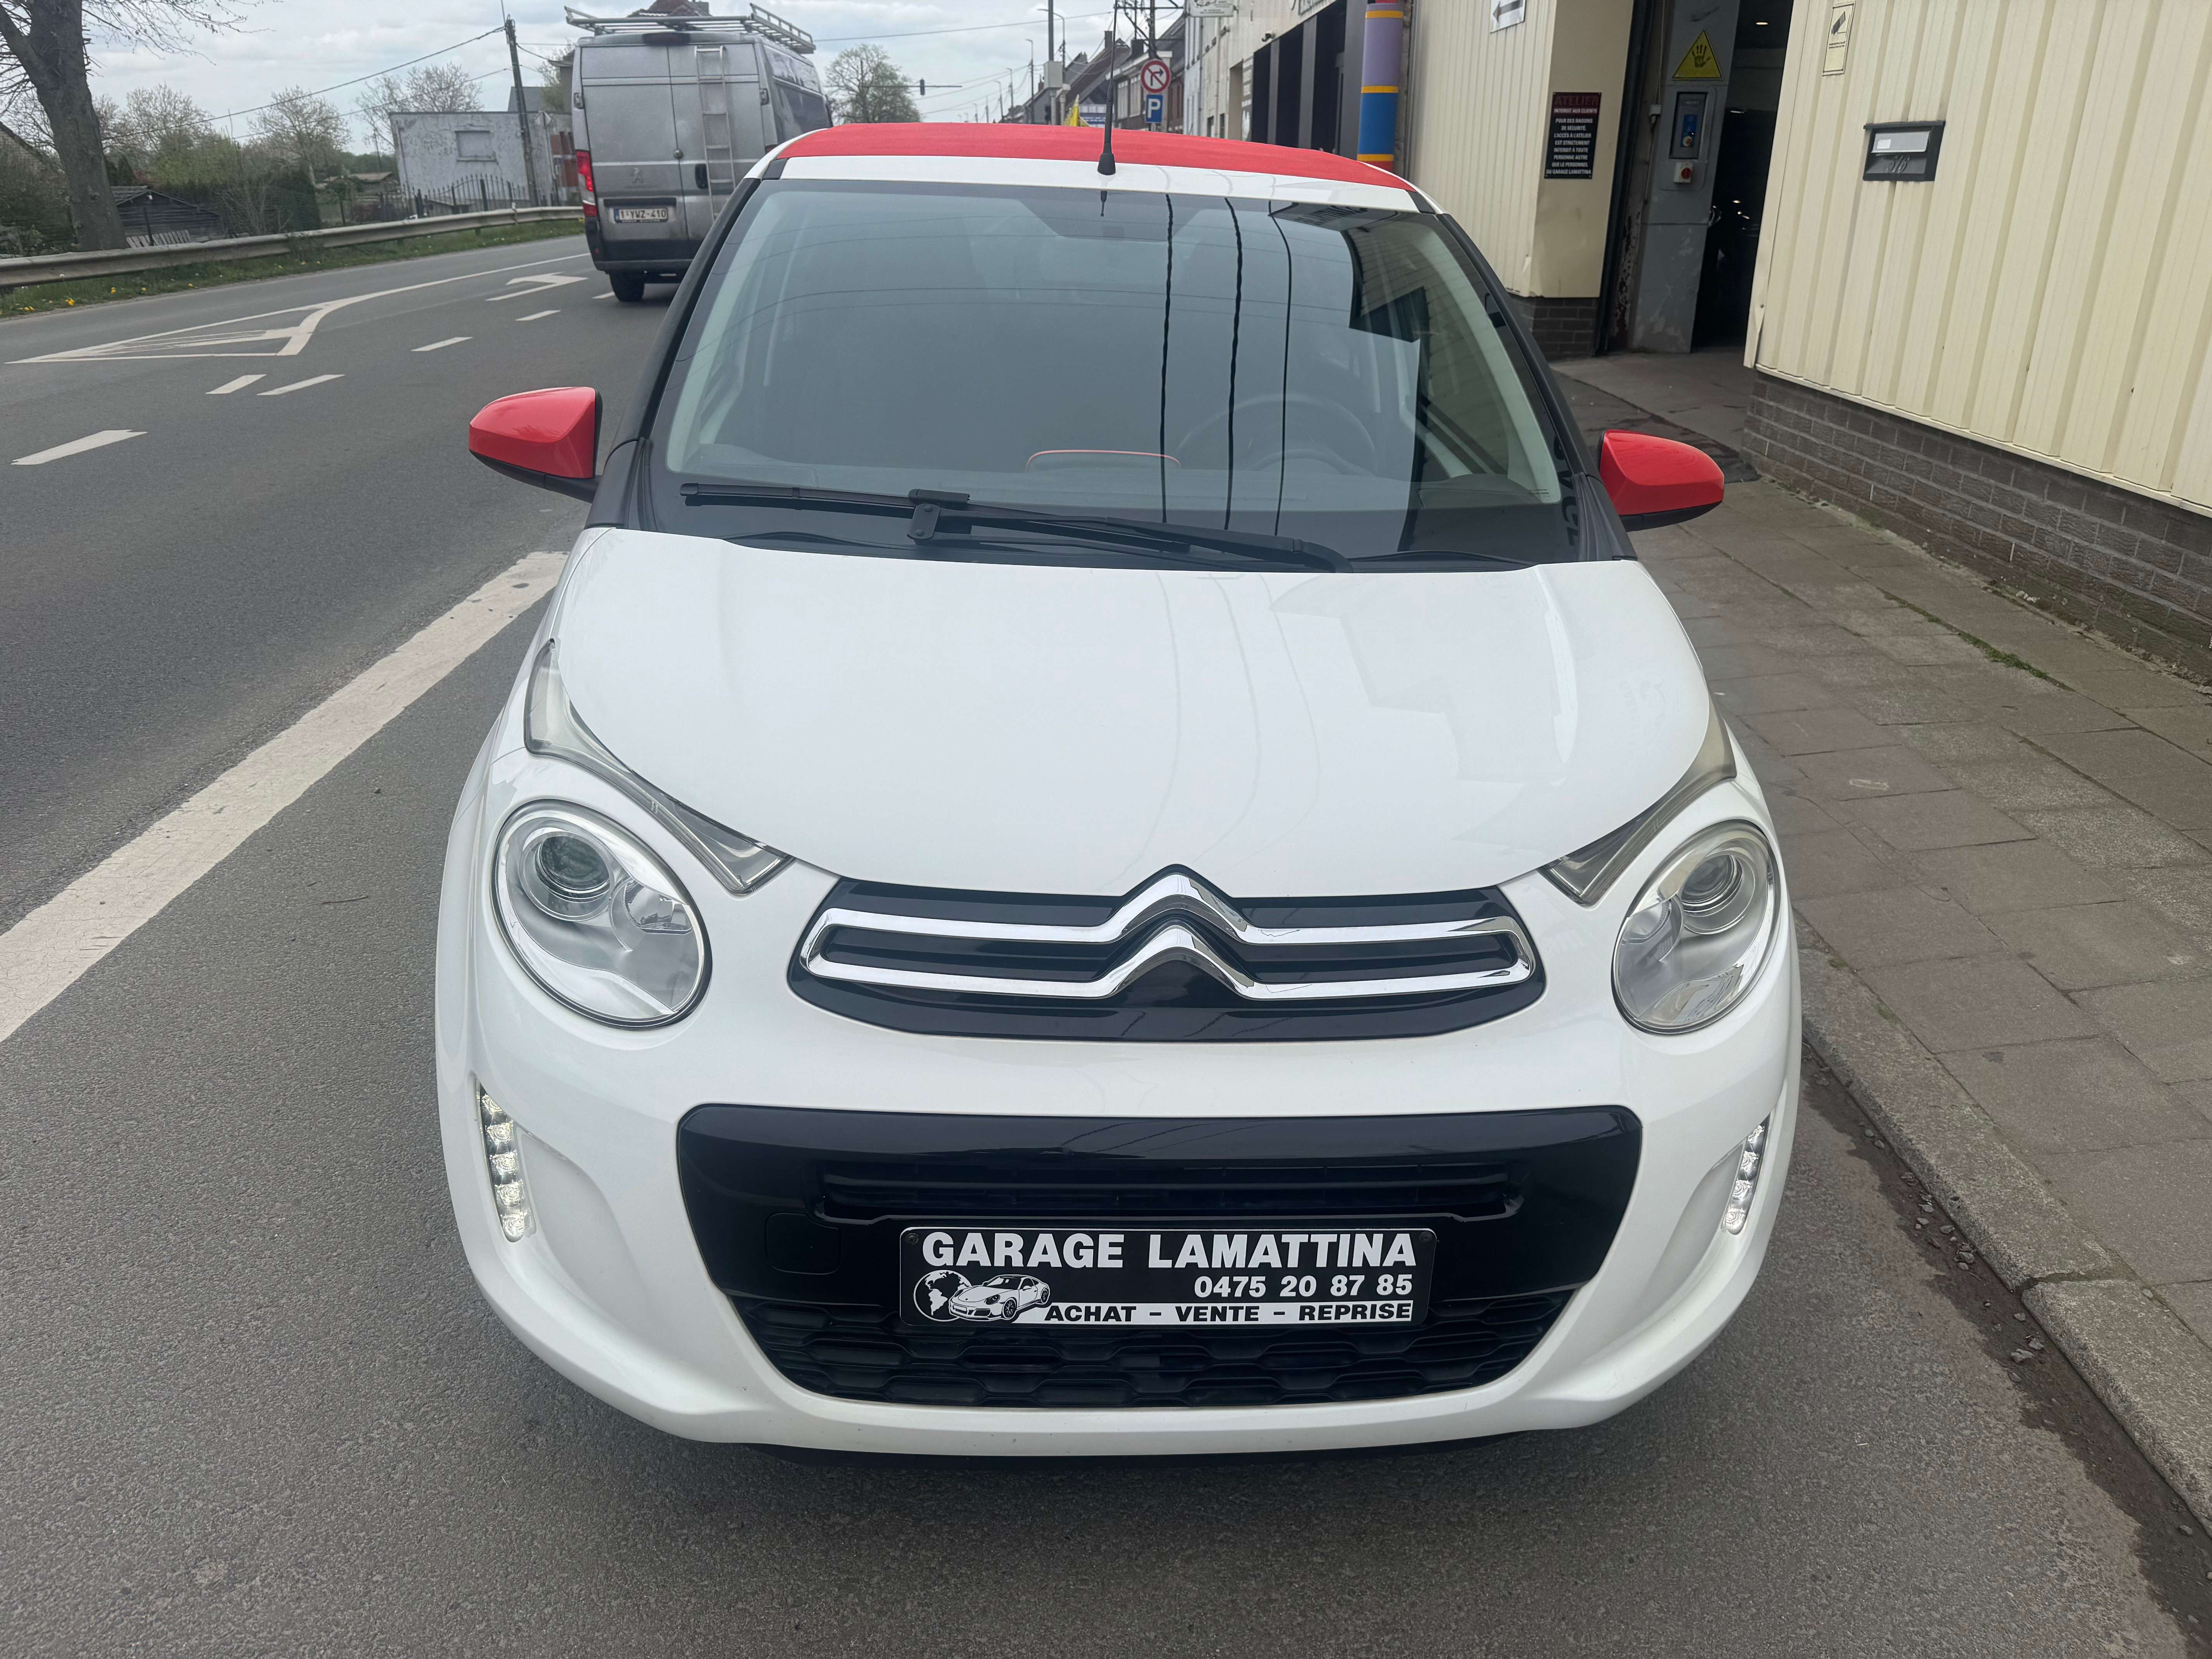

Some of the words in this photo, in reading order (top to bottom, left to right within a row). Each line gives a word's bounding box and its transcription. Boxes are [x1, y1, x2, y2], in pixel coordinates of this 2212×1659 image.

[1147, 99, 1161, 118] P
[1554, 96, 1599, 106] ATELIER
[922, 1231, 1124, 1268] GARAGE
[1148, 1233, 1416, 1268] LAMATTINA
[1194, 1276, 1266, 1298] 0475
[1279, 1275, 1317, 1297] 20
[1330, 1274, 1365, 1296] 87
[1376, 1274, 1413, 1295] 85
[1044, 1305, 1137, 1322] ACHAT
[1175, 1305, 1260, 1322] VENTE
[1299, 1303, 1412, 1321] REPRISE
